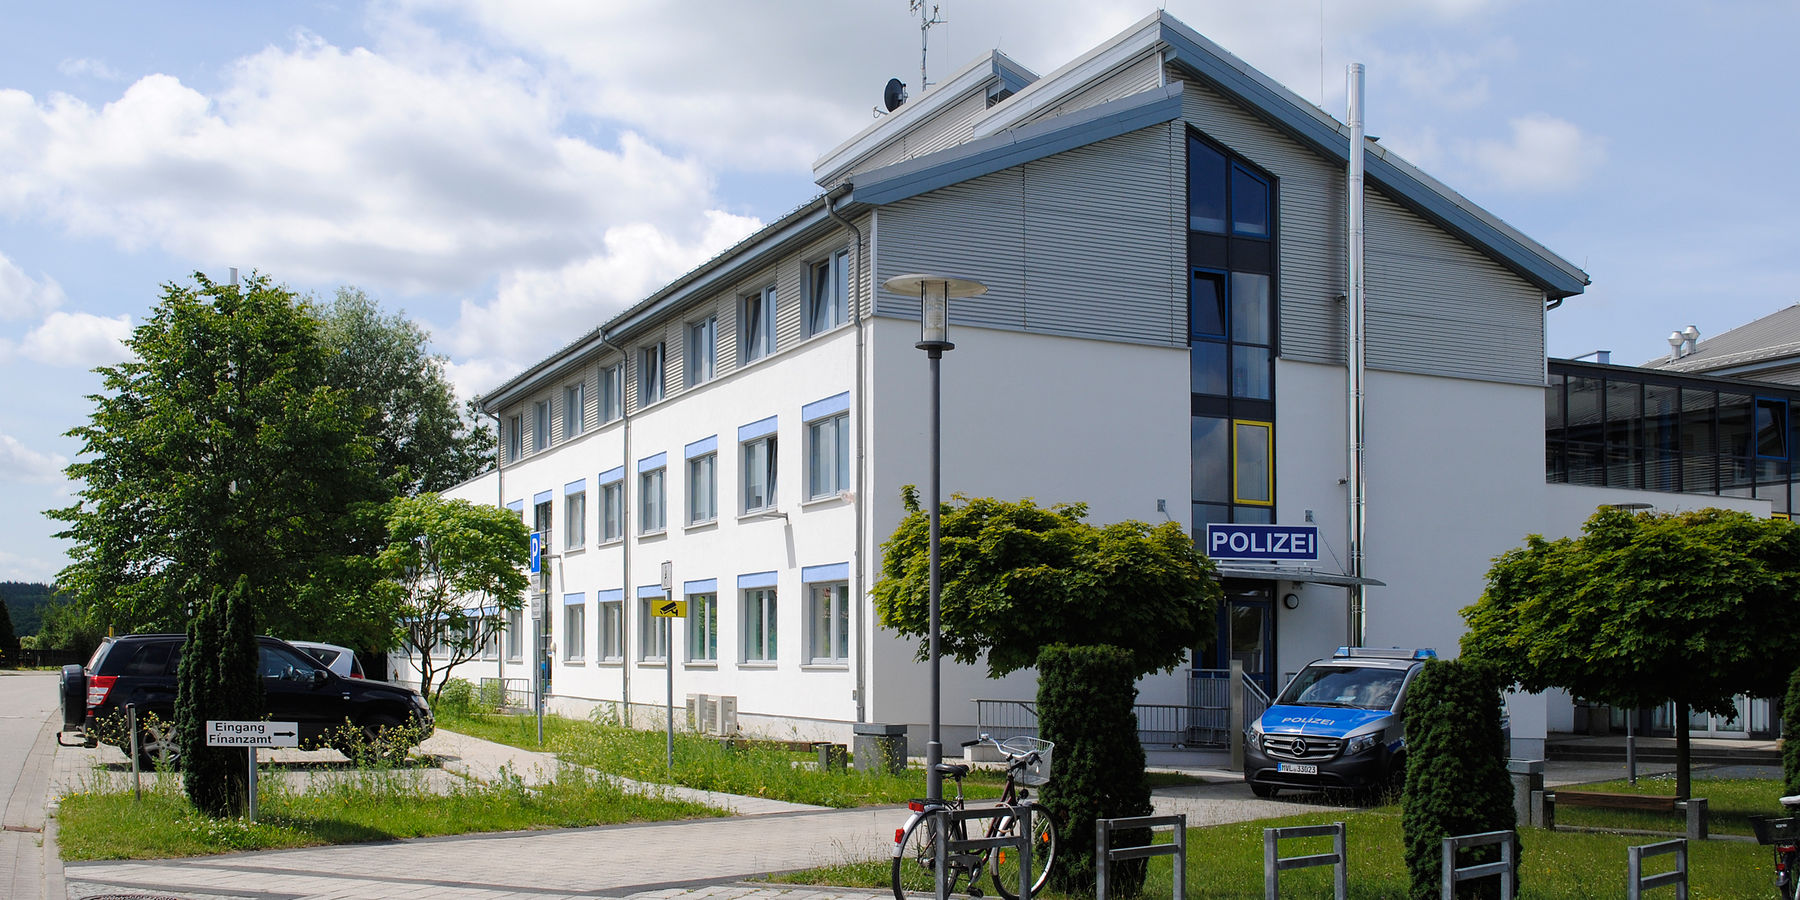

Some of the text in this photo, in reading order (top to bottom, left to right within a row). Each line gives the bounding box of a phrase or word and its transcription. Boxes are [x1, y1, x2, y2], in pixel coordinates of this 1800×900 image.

[1212, 532, 1314, 553] POLIZEI
[532, 538, 538, 568] P
[1281, 717, 1335, 726] POLIZEI
[215, 722, 265, 734] Eingang
[209, 733, 272, 744] Finanzamt
